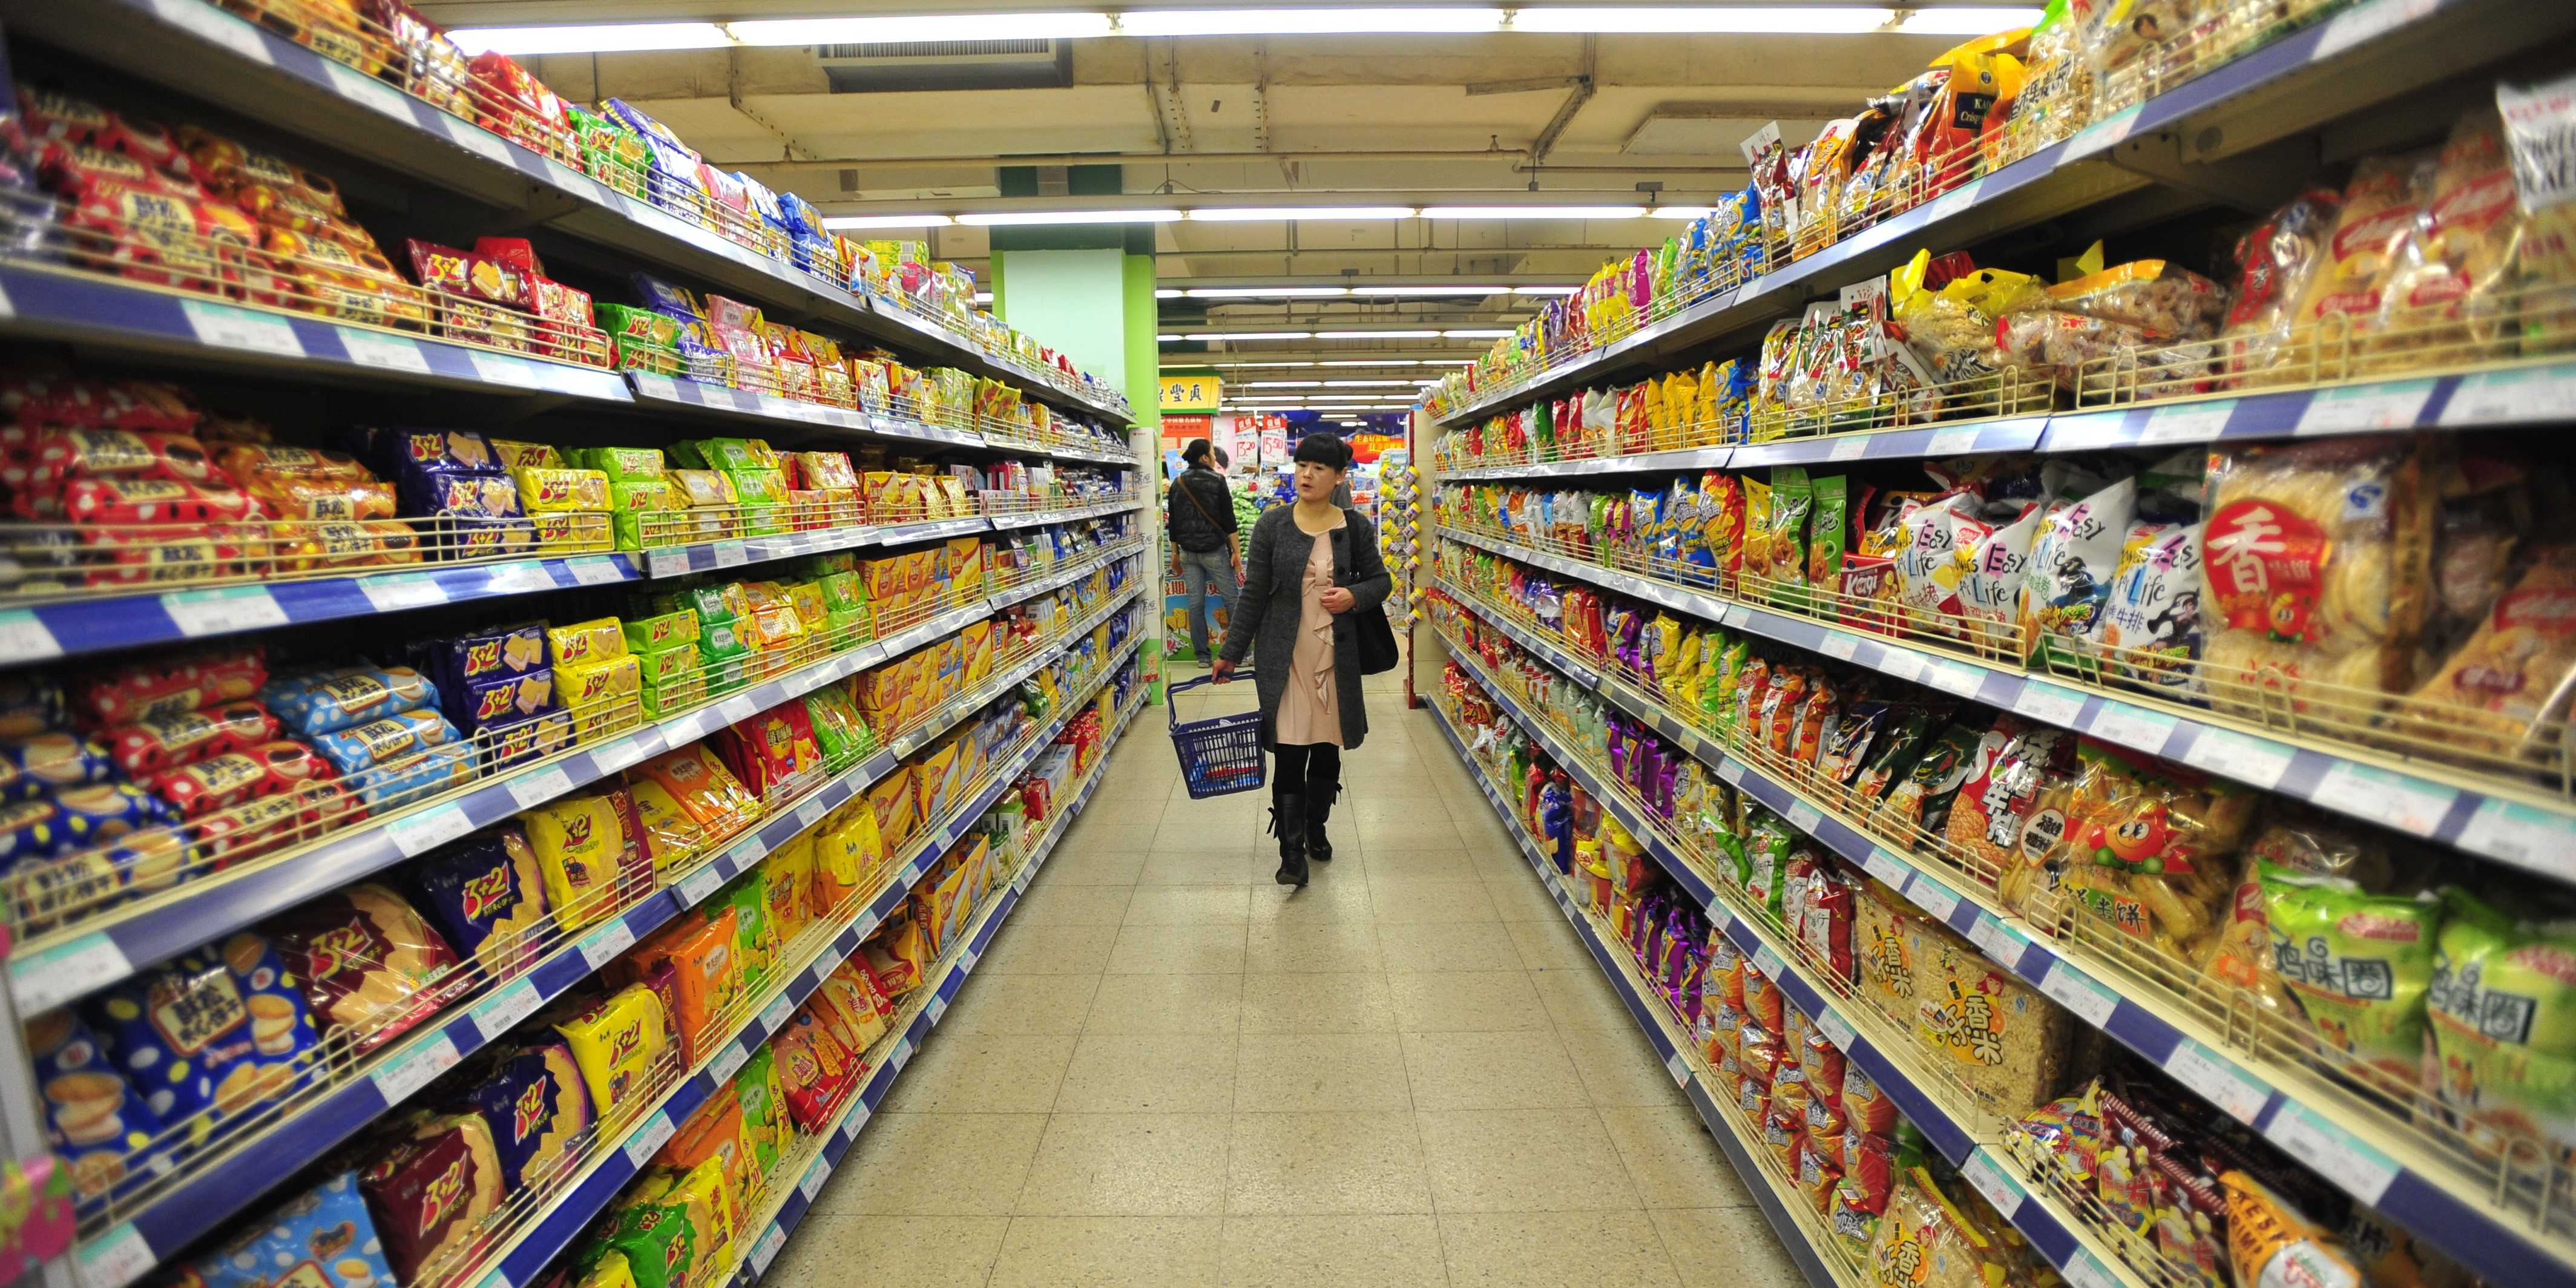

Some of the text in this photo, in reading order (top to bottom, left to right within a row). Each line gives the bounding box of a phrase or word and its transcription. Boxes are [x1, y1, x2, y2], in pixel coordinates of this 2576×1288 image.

[429, 253, 465, 282] 3+2
[410, 433, 443, 462] 3+2
[1916, 519, 1952, 550] Easy
[2207, 506, 2287, 593] 香
[1908, 548, 1937, 577] Life
[1985, 542, 2028, 573] Easy
[1972, 575, 2009, 606] Life
[2128, 565, 2167, 607] Life
[465, 642, 502, 677] 3+2
[477, 684, 516, 720] 3+2
[582, 670, 610, 702] 3+2
[463, 866, 510, 921] 3+2
[309, 926, 366, 980] 3+2
[610, 1019, 640, 1070] 3+2
[516, 1083, 544, 1142] 3+2
[422, 1160, 461, 1234] 3+2
